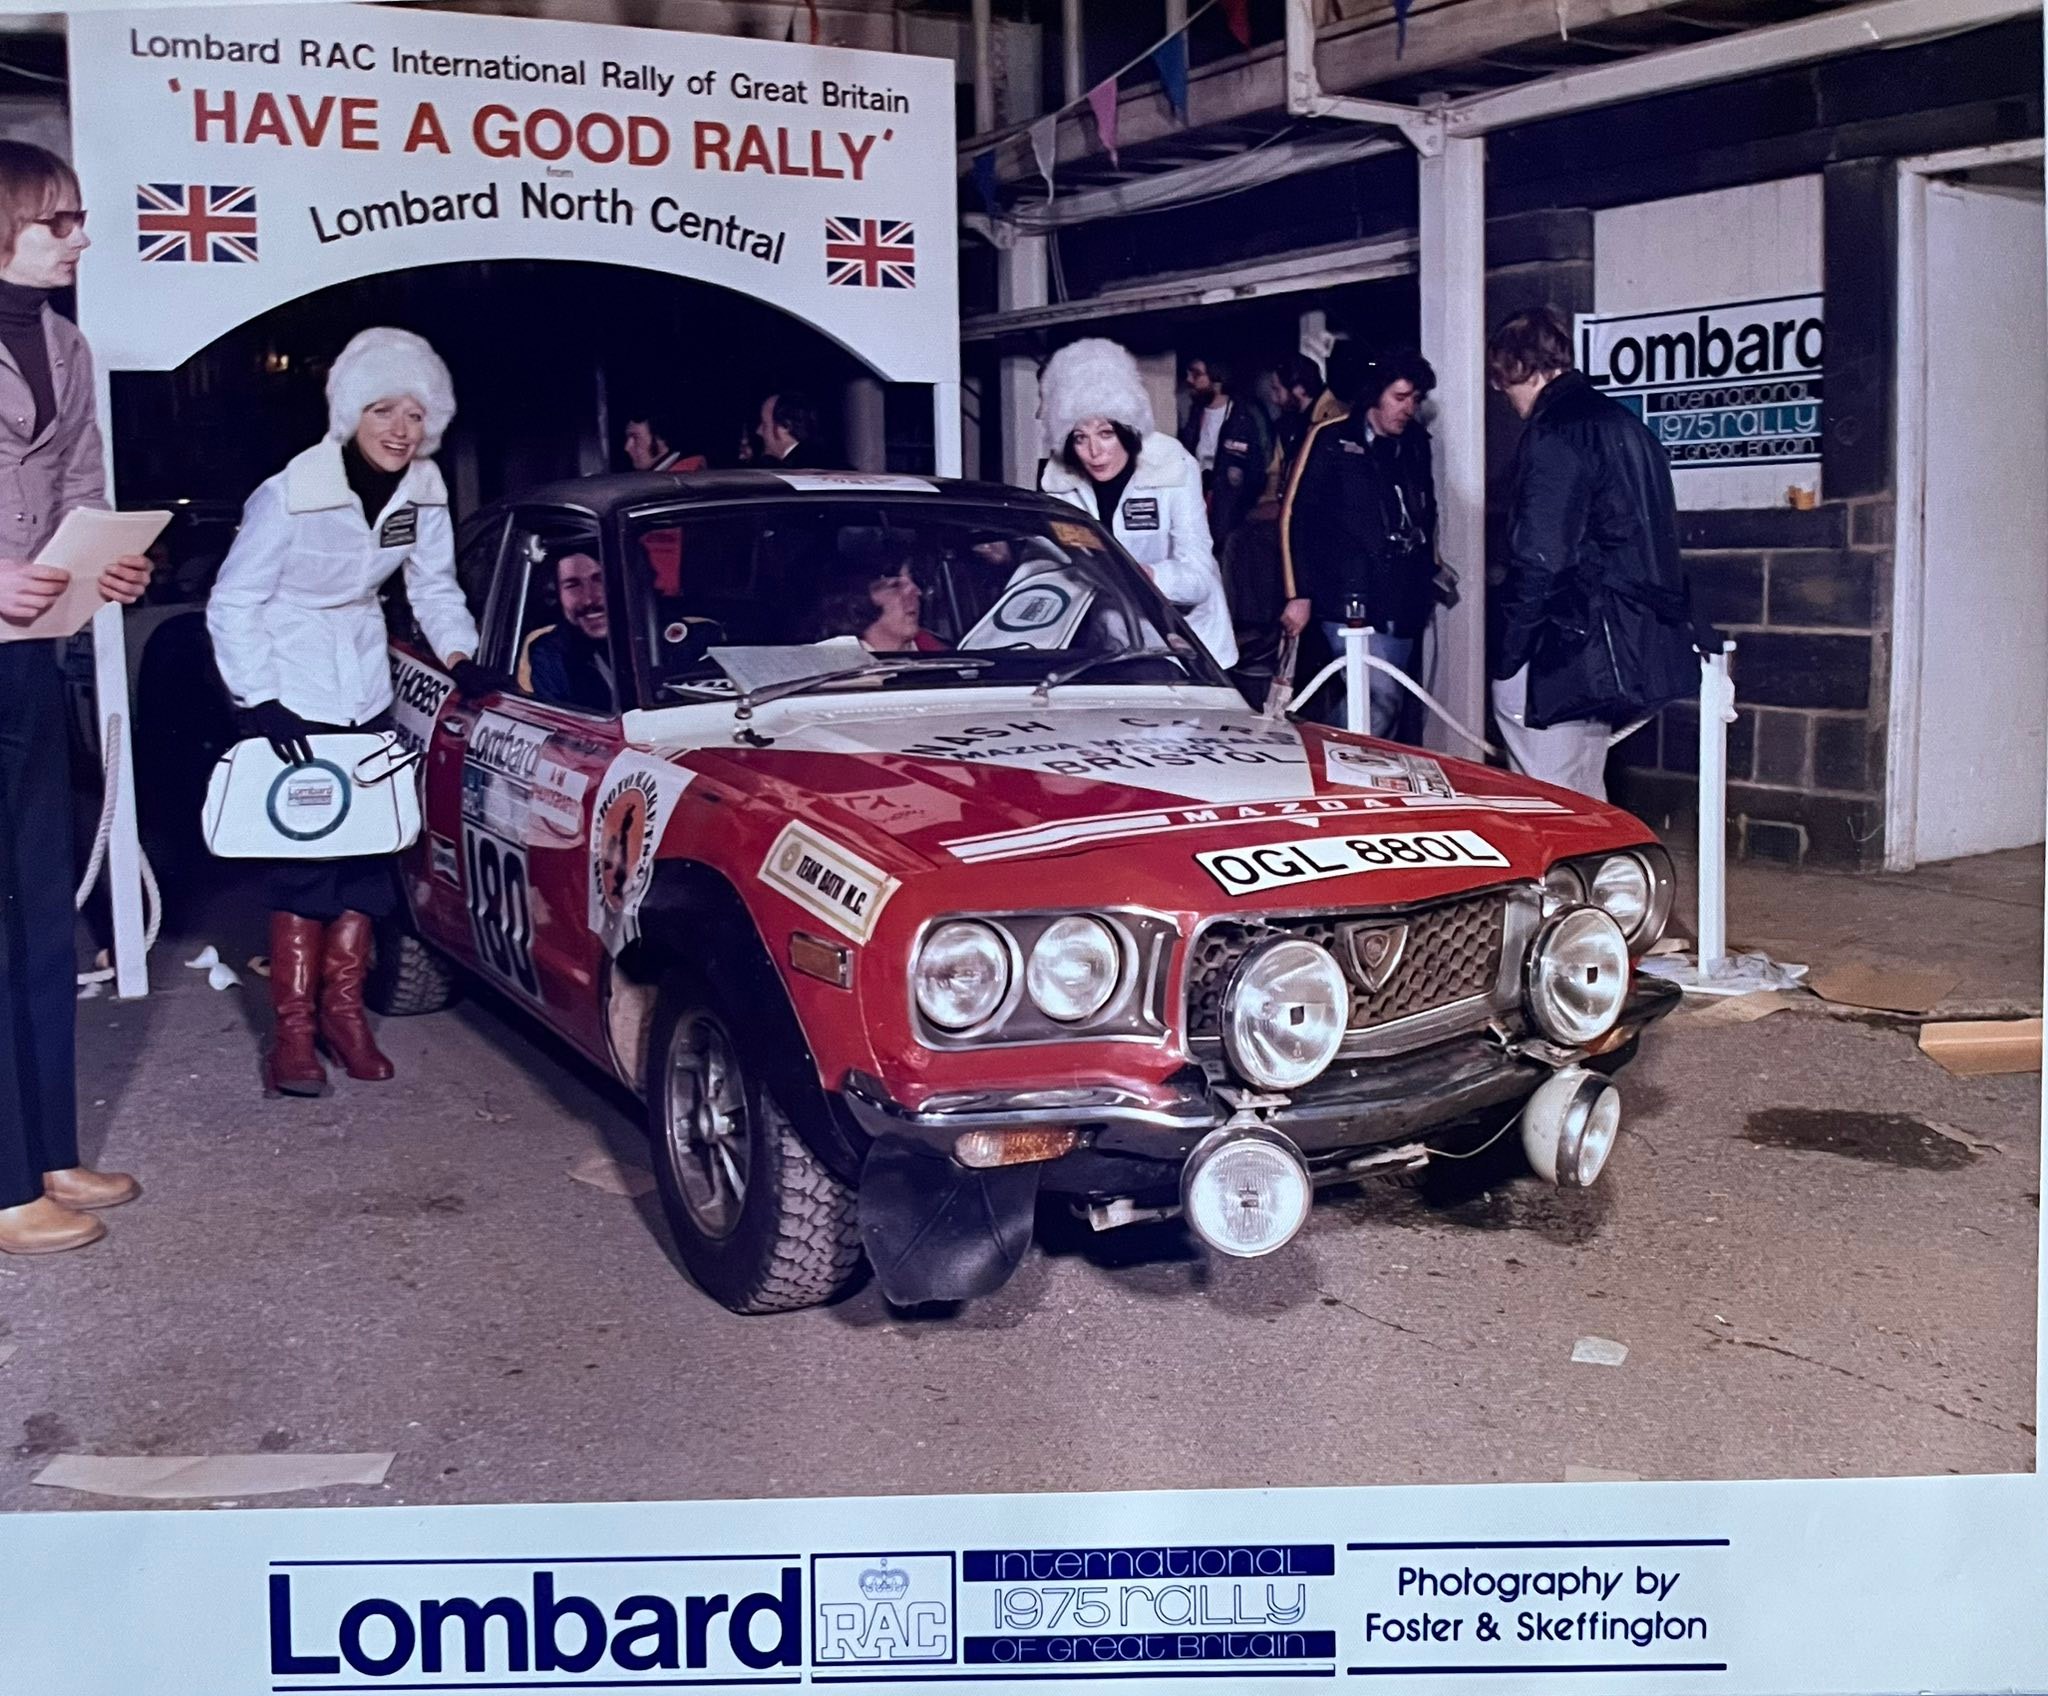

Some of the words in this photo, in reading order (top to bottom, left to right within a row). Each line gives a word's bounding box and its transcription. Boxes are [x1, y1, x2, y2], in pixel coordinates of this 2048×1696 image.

[130, 28, 281, 64] Lombard
[300, 39, 376, 71] RAC
[392, 47, 586, 85] International
[602, 61, 674, 97] Rally
[687, 70, 717, 95] of
[730, 73, 809, 104] Great
[822, 81, 910, 113] Britain
[403, 102, 451, 154] A
[472, 104, 670, 167] GOOD
[309, 182, 497, 244] Lombard
[521, 182, 633, 226] North
[651, 196, 785, 264] Central
[1658, 412, 1715, 440] 1975
[901, 721, 1057, 757] NASH
[950, 742, 1082, 761] MAZDA
[1041, 750, 1308, 775] BRISTOL
[1186, 798, 1391, 824] MAZDA
[796, 854, 824, 885] TEAM
[817, 868, 847, 900] BATH
[1211, 845, 1350, 886] OGL
[1345, 834, 1500, 865] 880L
[1398, 1566, 1624, 1602] Photography
[1634, 1568, 1682, 1602] by
[268, 1567, 802, 1677] Lombard
[994, 1587, 1111, 1631] 1975
[820, 1601, 948, 1661] RAC
[1177, 1632, 1306, 1659] Britain
[1365, 1612, 1463, 1645] Foster
[1475, 1614, 1501, 1642] &
[1516, 1611, 1708, 1648] Skeffington
